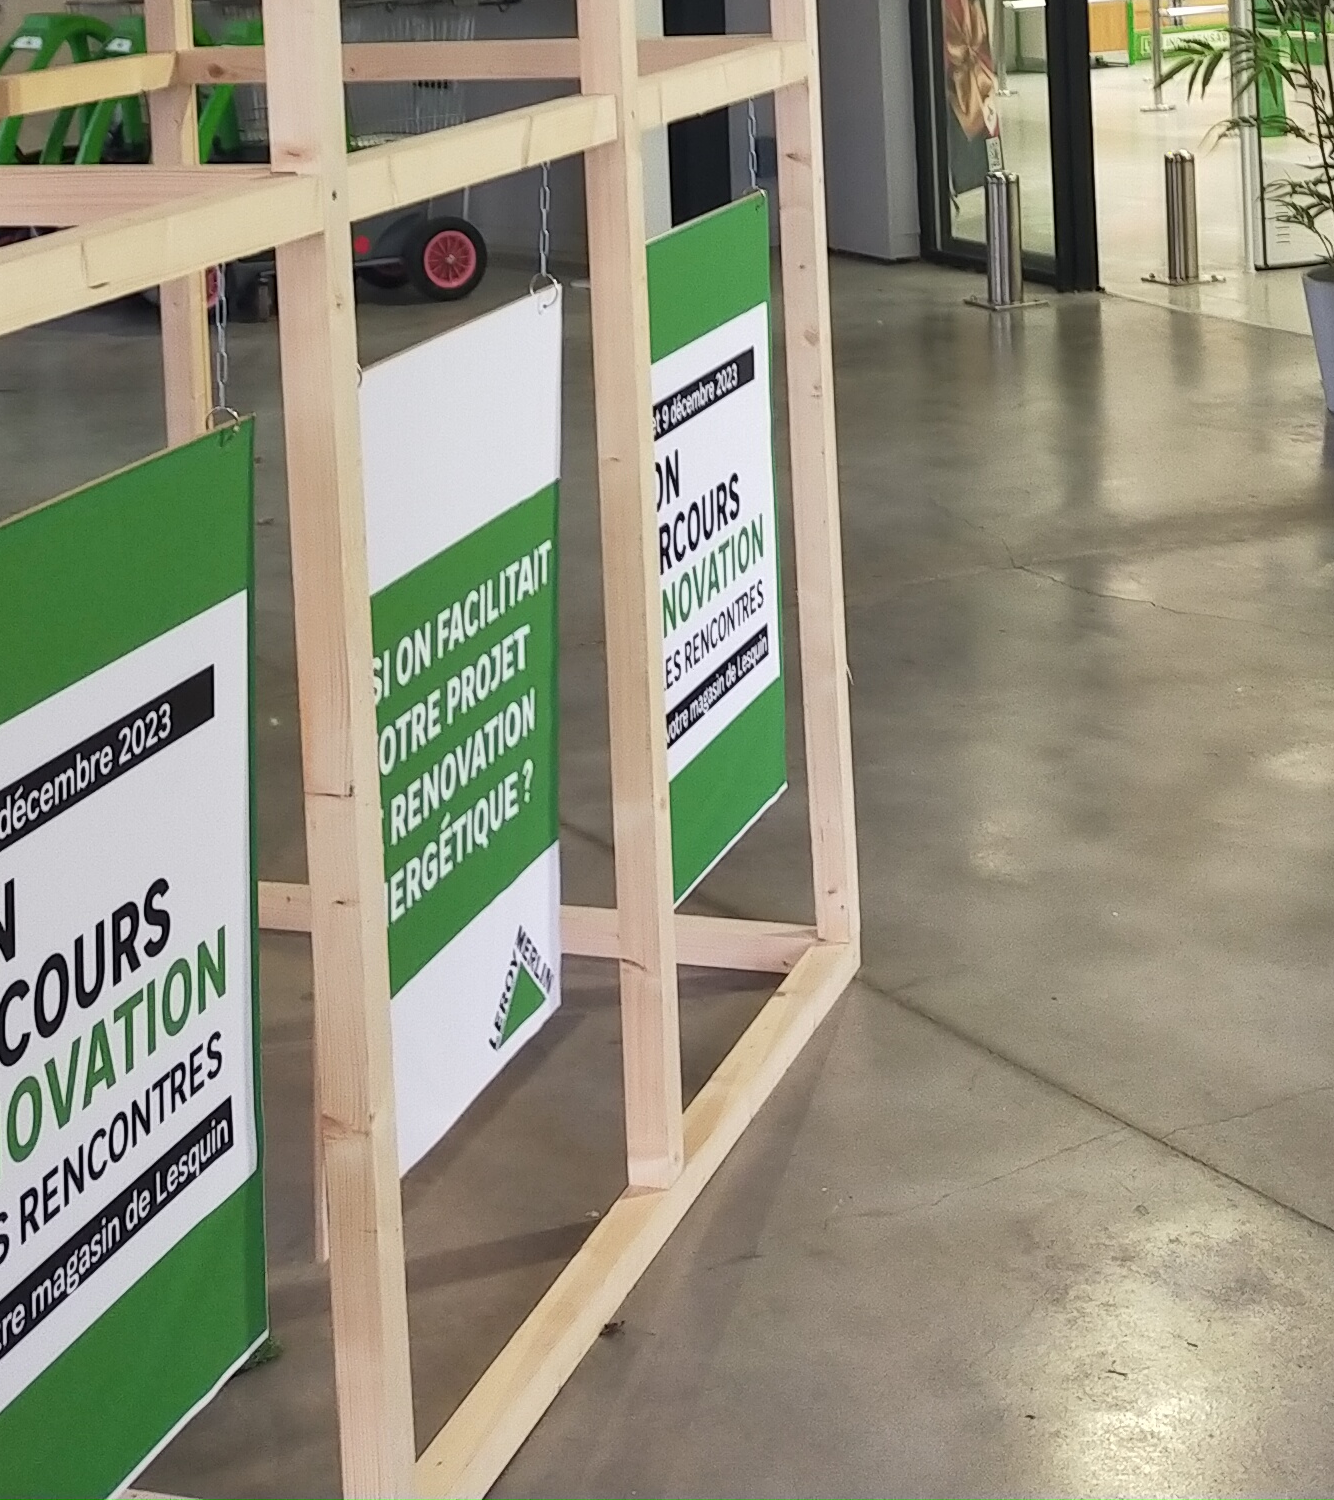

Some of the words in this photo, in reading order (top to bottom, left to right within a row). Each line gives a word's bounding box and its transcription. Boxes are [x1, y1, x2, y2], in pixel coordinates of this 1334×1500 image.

[715, 362, 738, 397] 2023
[659, 472, 740, 575] RCOURS
[372, 649, 391, 706] SI
[396, 621, 431, 687] ON
[437, 539, 552, 660] FACILITAIT
[684, 579, 764, 673] RENCONTRES
[689, 674, 725, 714] magasin
[725, 662, 737, 688] de
[737, 633, 767, 677] Lesquin
[117, 701, 172, 767] 2023
[378, 688, 442, 776] OTRE
[446, 624, 530, 726] PROJET
[390, 687, 536, 847] RENOVATION
[387, 771, 520, 924] ERGÉTIQUE
[489, 948, 519, 1051] LEROY
[516, 925, 554, 994] MERLIN
[19, 1030, 224, 1246] RENCONTRES
[29, 1213, 121, 1321] magasin
[124, 1186, 152, 1233] de
[154, 1113, 233, 1200] Lesquin
